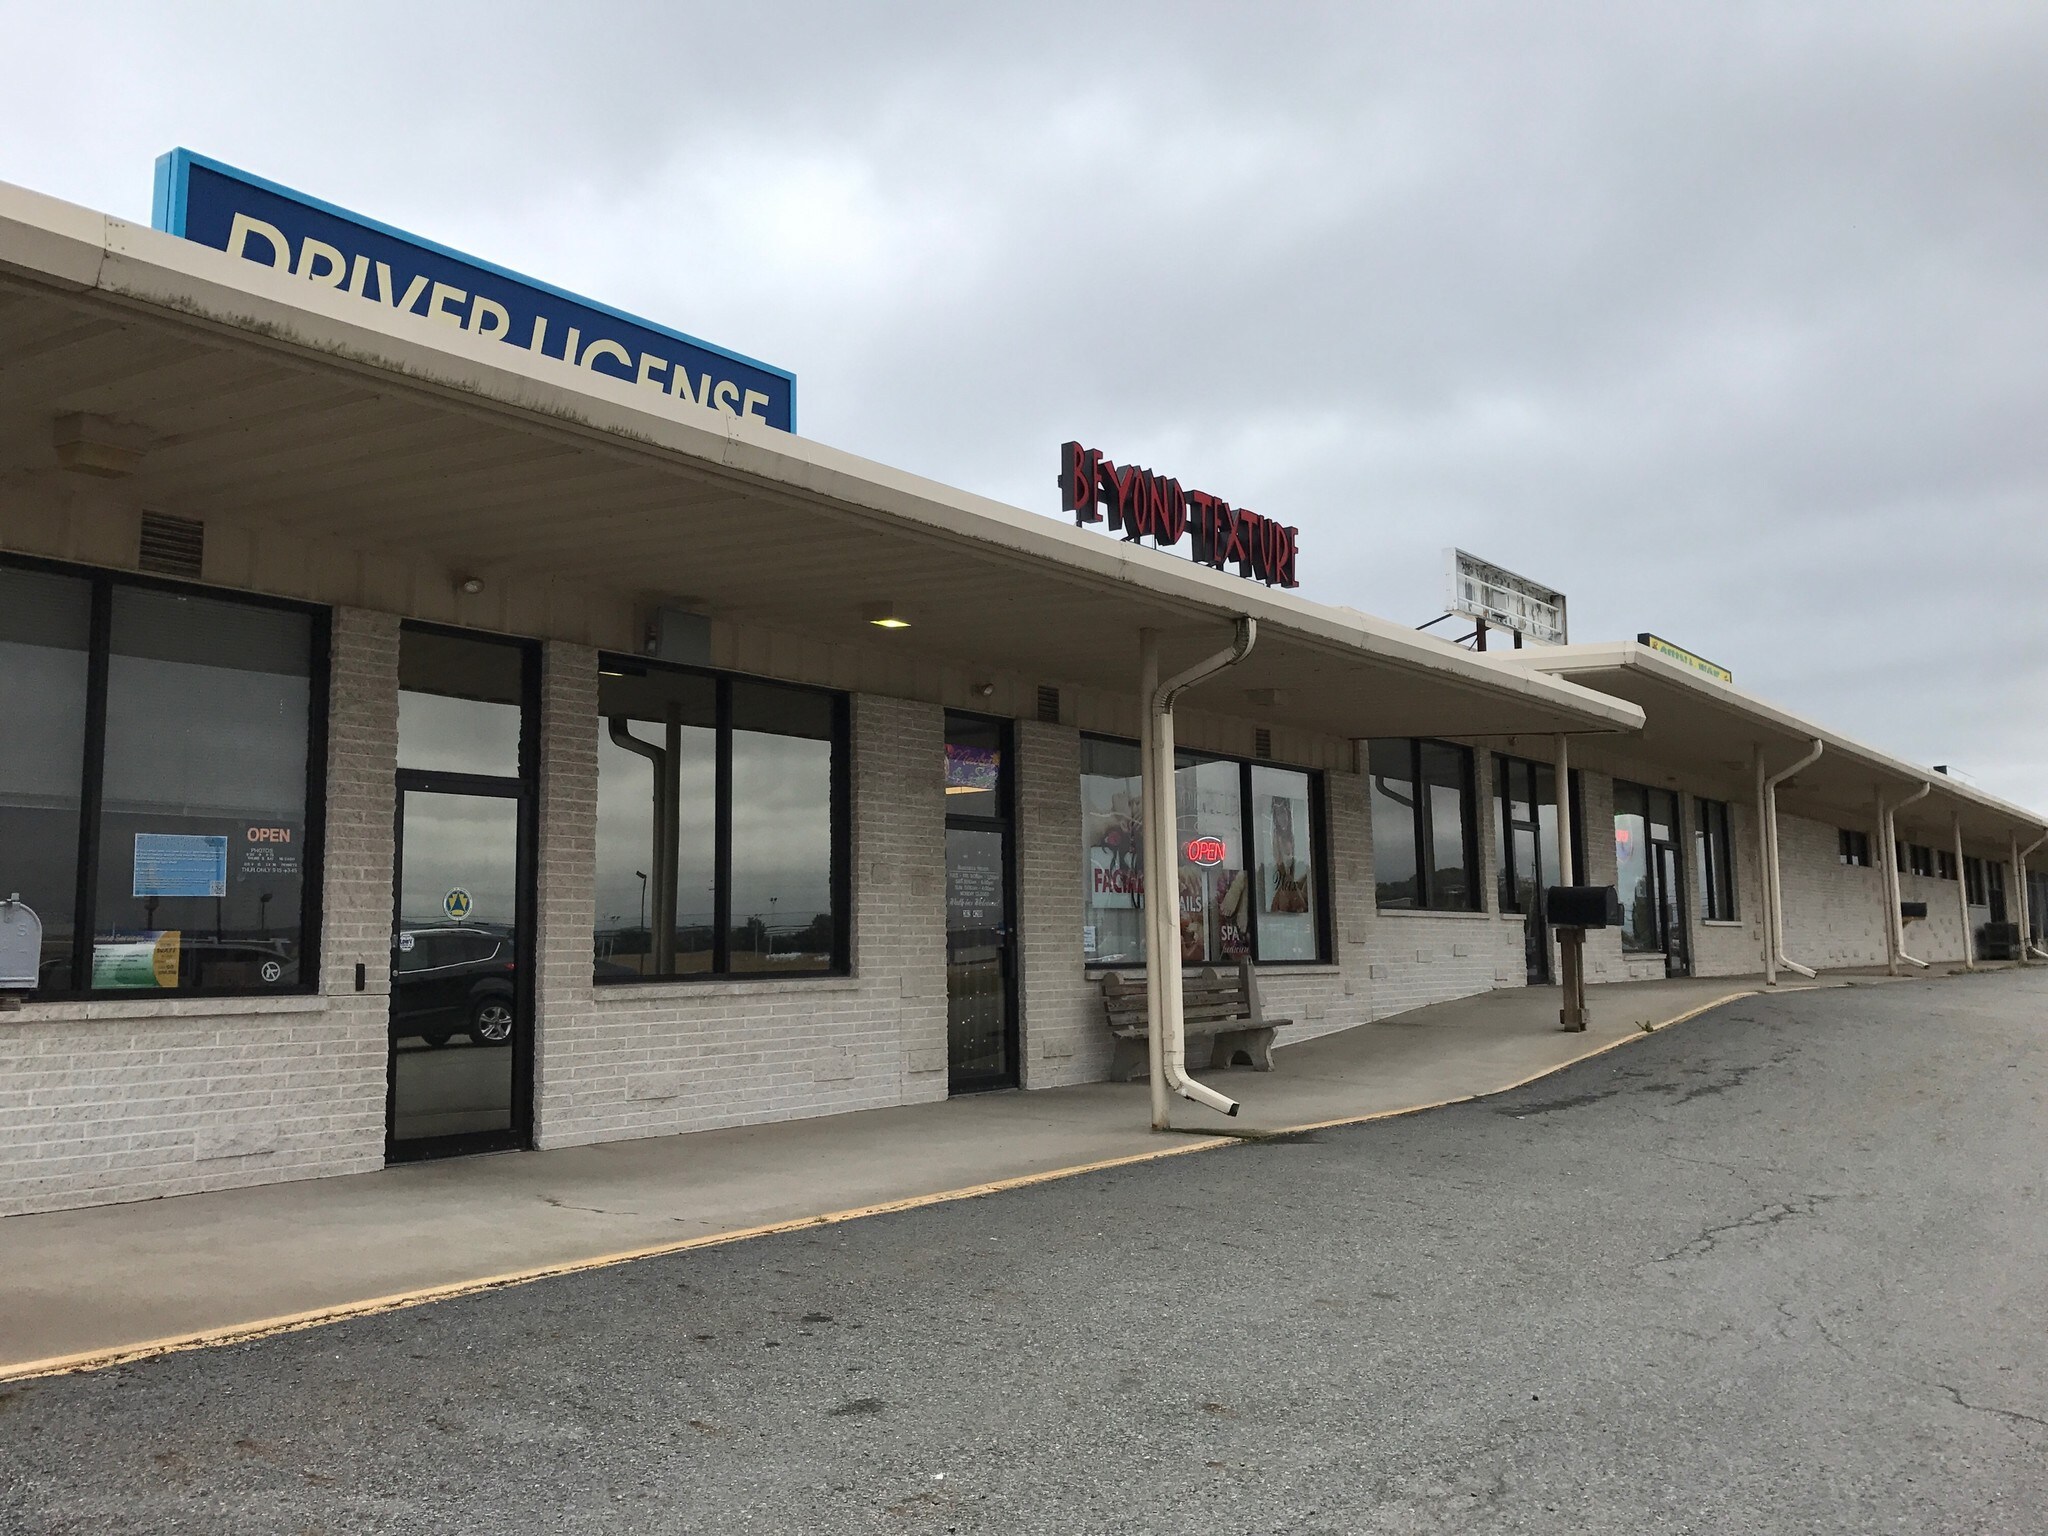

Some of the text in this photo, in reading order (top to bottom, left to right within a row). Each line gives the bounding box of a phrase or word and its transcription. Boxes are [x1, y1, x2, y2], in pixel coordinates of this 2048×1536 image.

[1066, 441, 1299, 588] BEYOND TEXTURE
[247, 827, 290, 843] OPEN
[1188, 841, 1226, 861] OPEN
[1179, 895, 1203, 913] AILS
[1221, 925, 1240, 941] SPA
